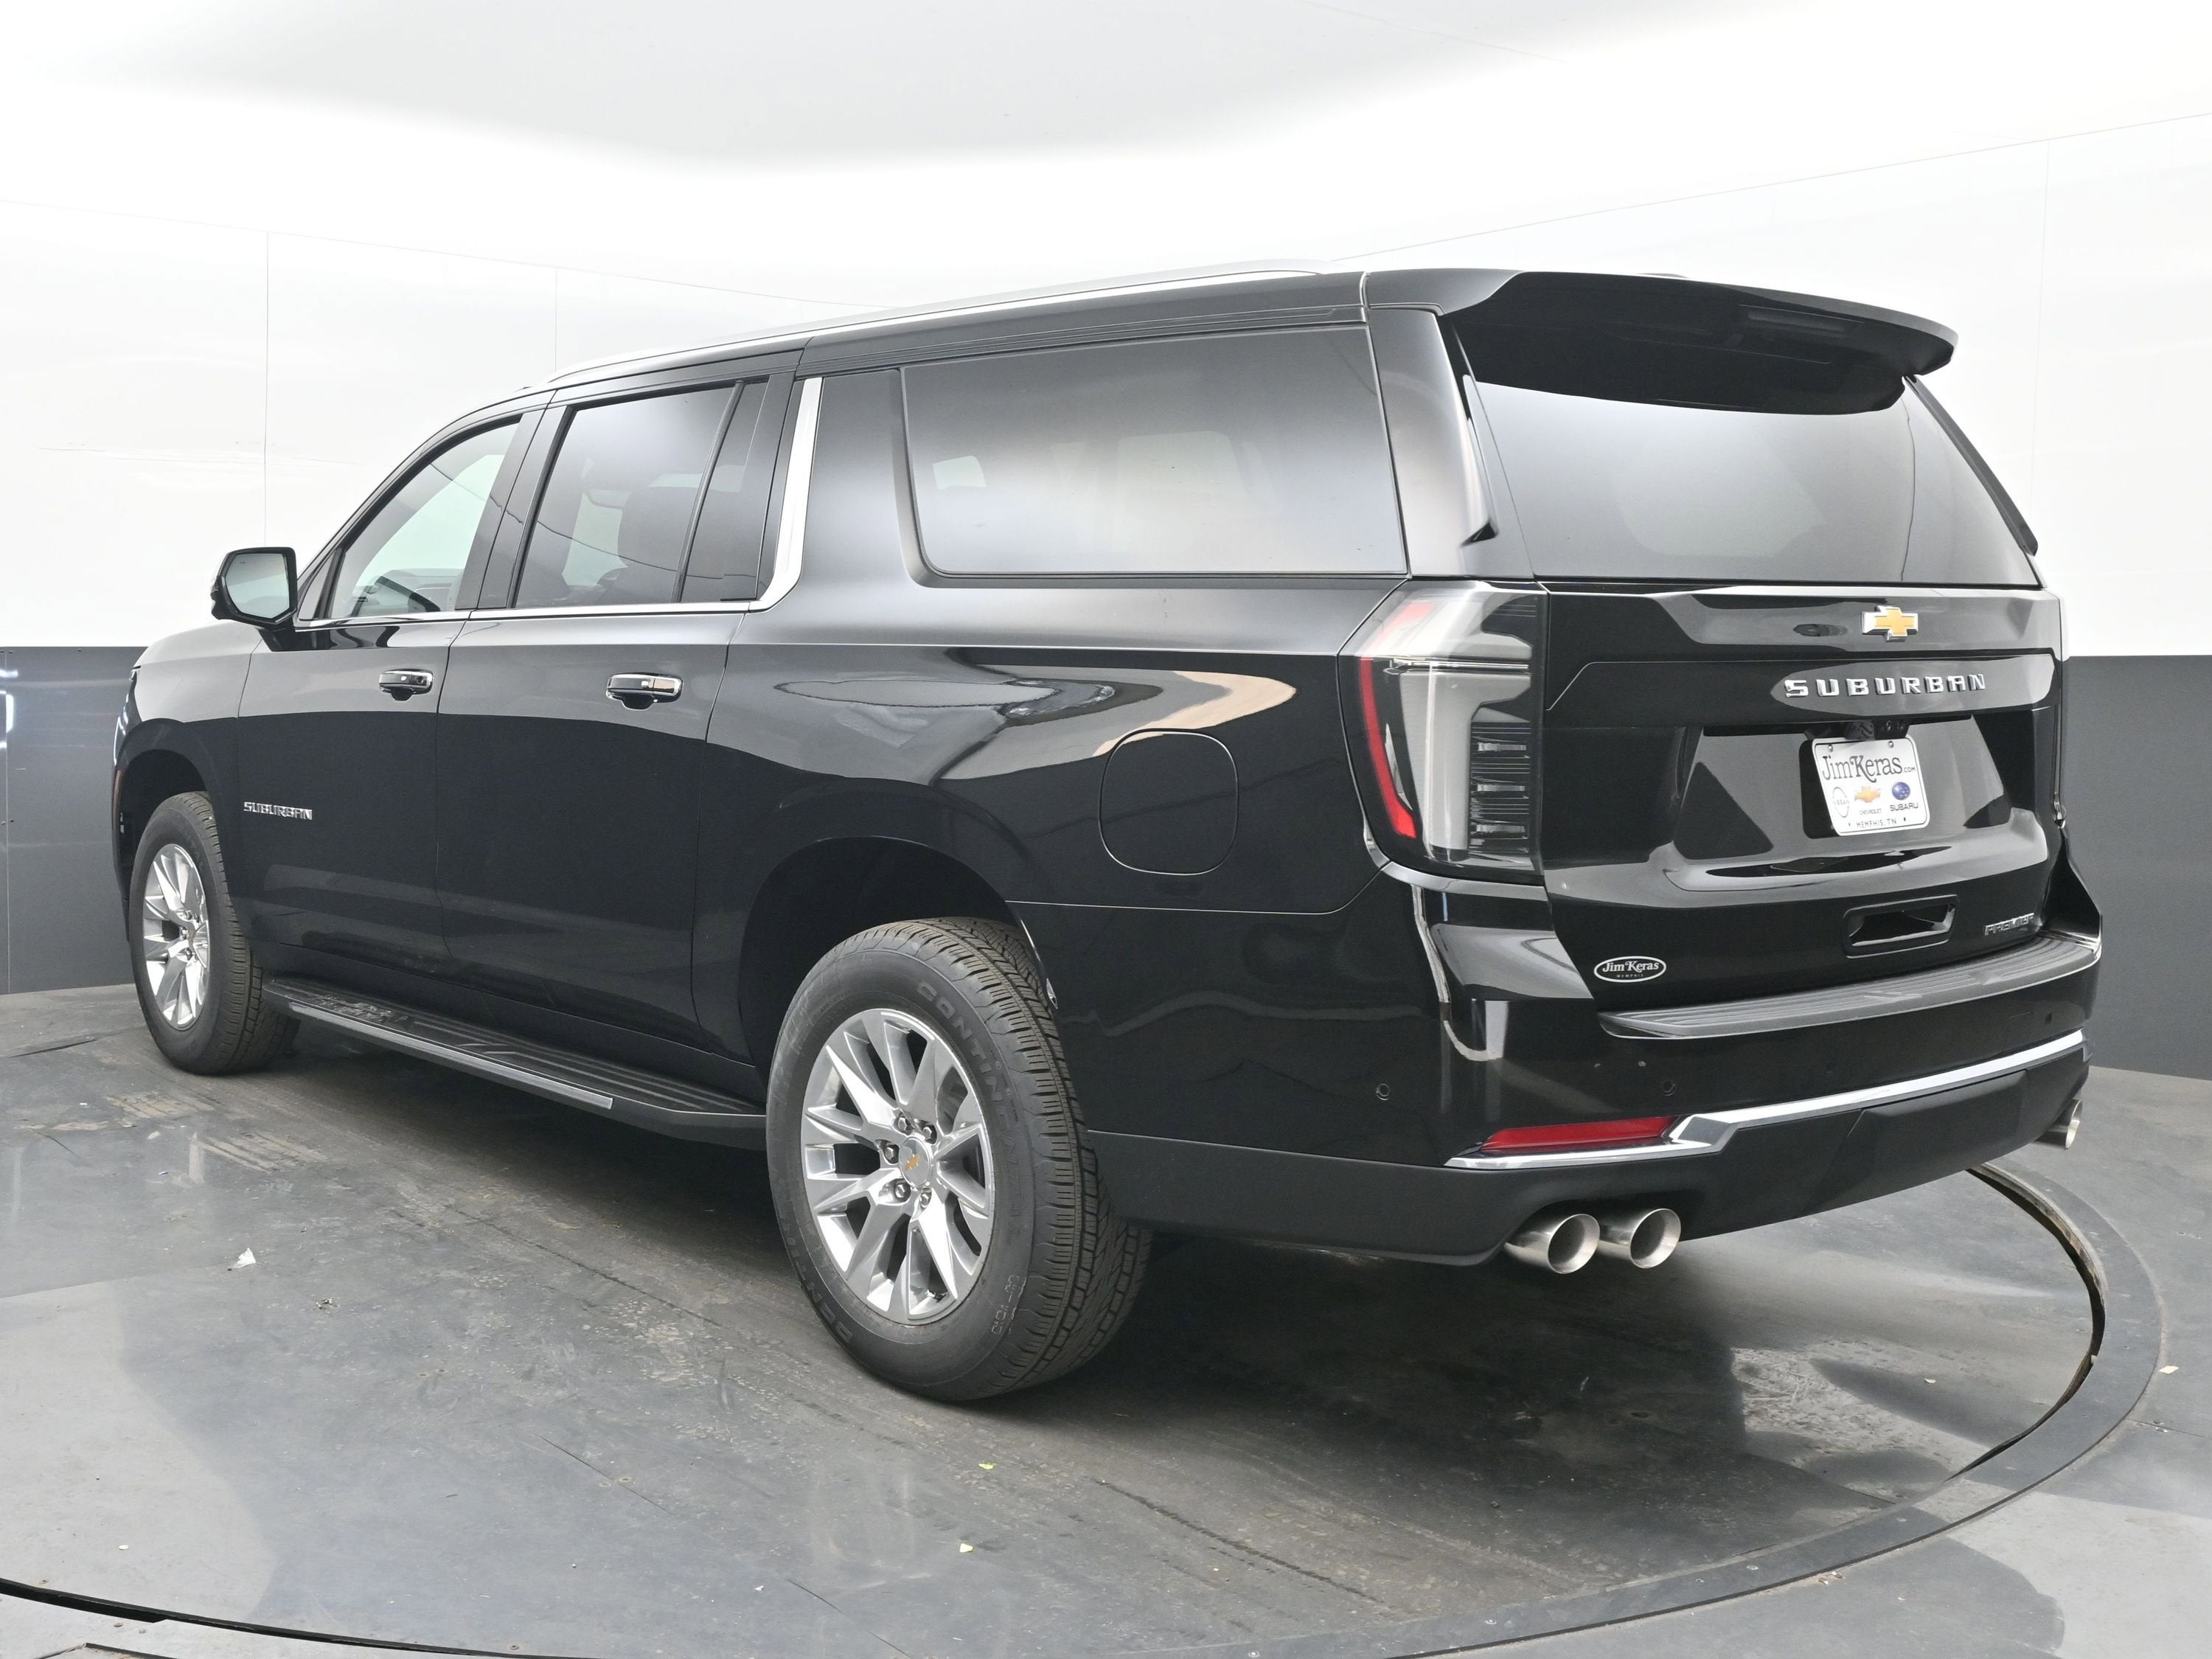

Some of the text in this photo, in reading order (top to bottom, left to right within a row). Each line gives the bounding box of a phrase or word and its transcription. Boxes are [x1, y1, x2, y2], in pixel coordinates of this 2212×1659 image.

[1785, 674, 1986, 697] SUBURBAN
[243, 801, 313, 821] SUBURBAN
[1889, 801, 1919, 812] SUBARU
